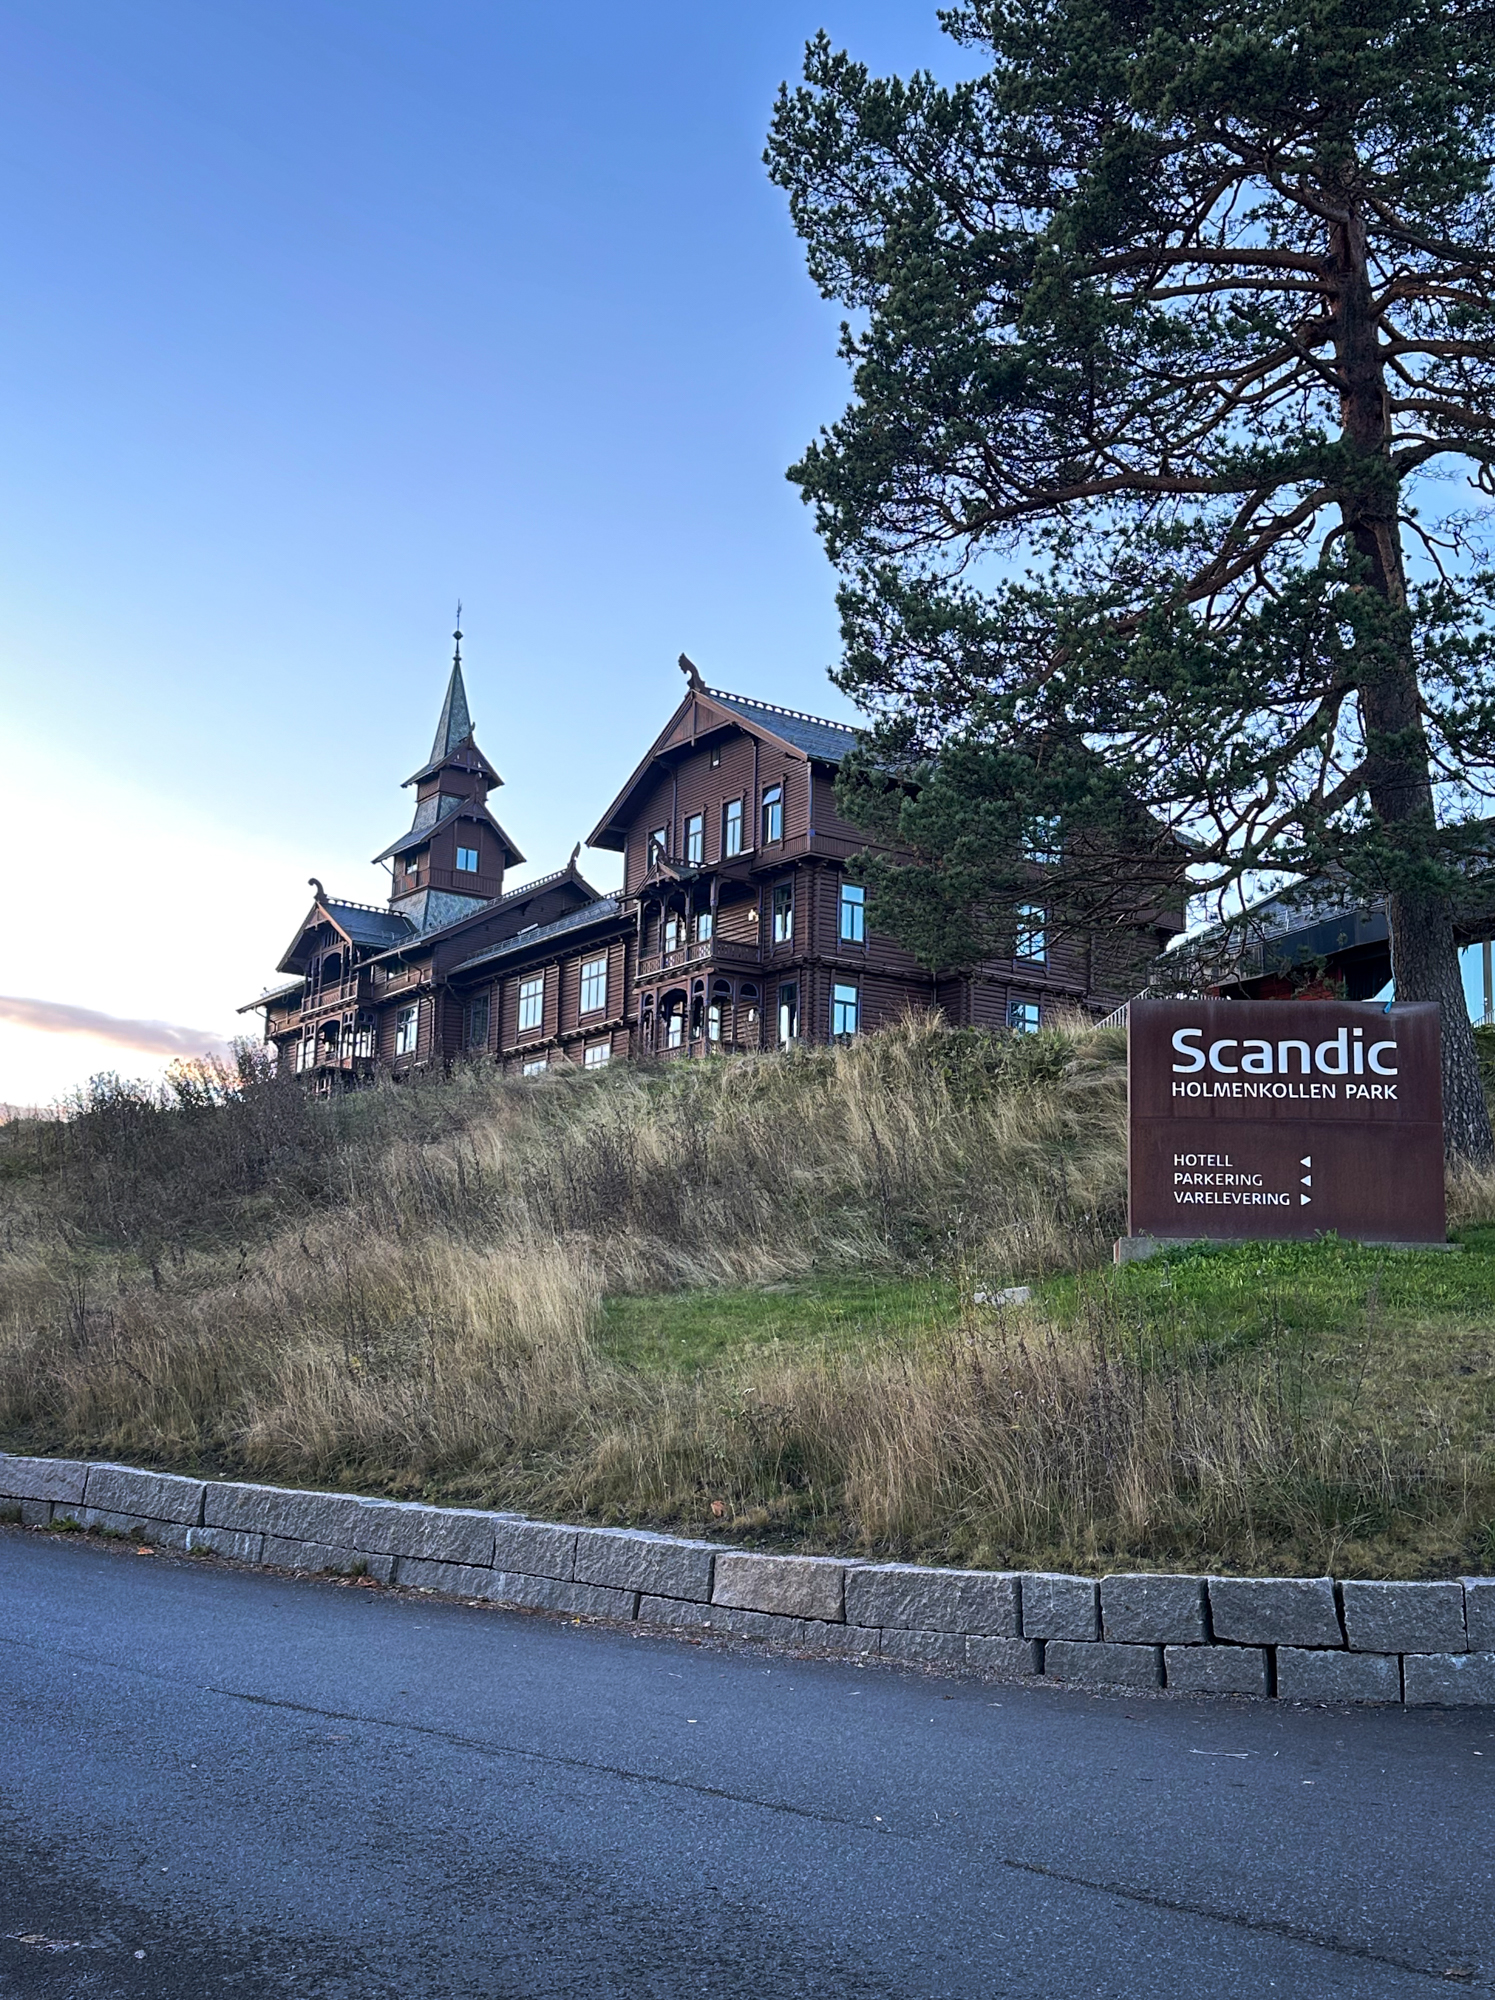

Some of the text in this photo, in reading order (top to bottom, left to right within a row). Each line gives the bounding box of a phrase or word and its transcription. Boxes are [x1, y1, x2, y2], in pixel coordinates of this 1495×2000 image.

[1171, 1027, 1398, 1075] Scandic
[1172, 1081, 1398, 1100] HOLMENKOLLEN PARK
[1173, 1153, 1233, 1167] HOTELL
[1173, 1172, 1263, 1187] PARKERING
[1173, 1191, 1291, 1206] VARELEVERING
